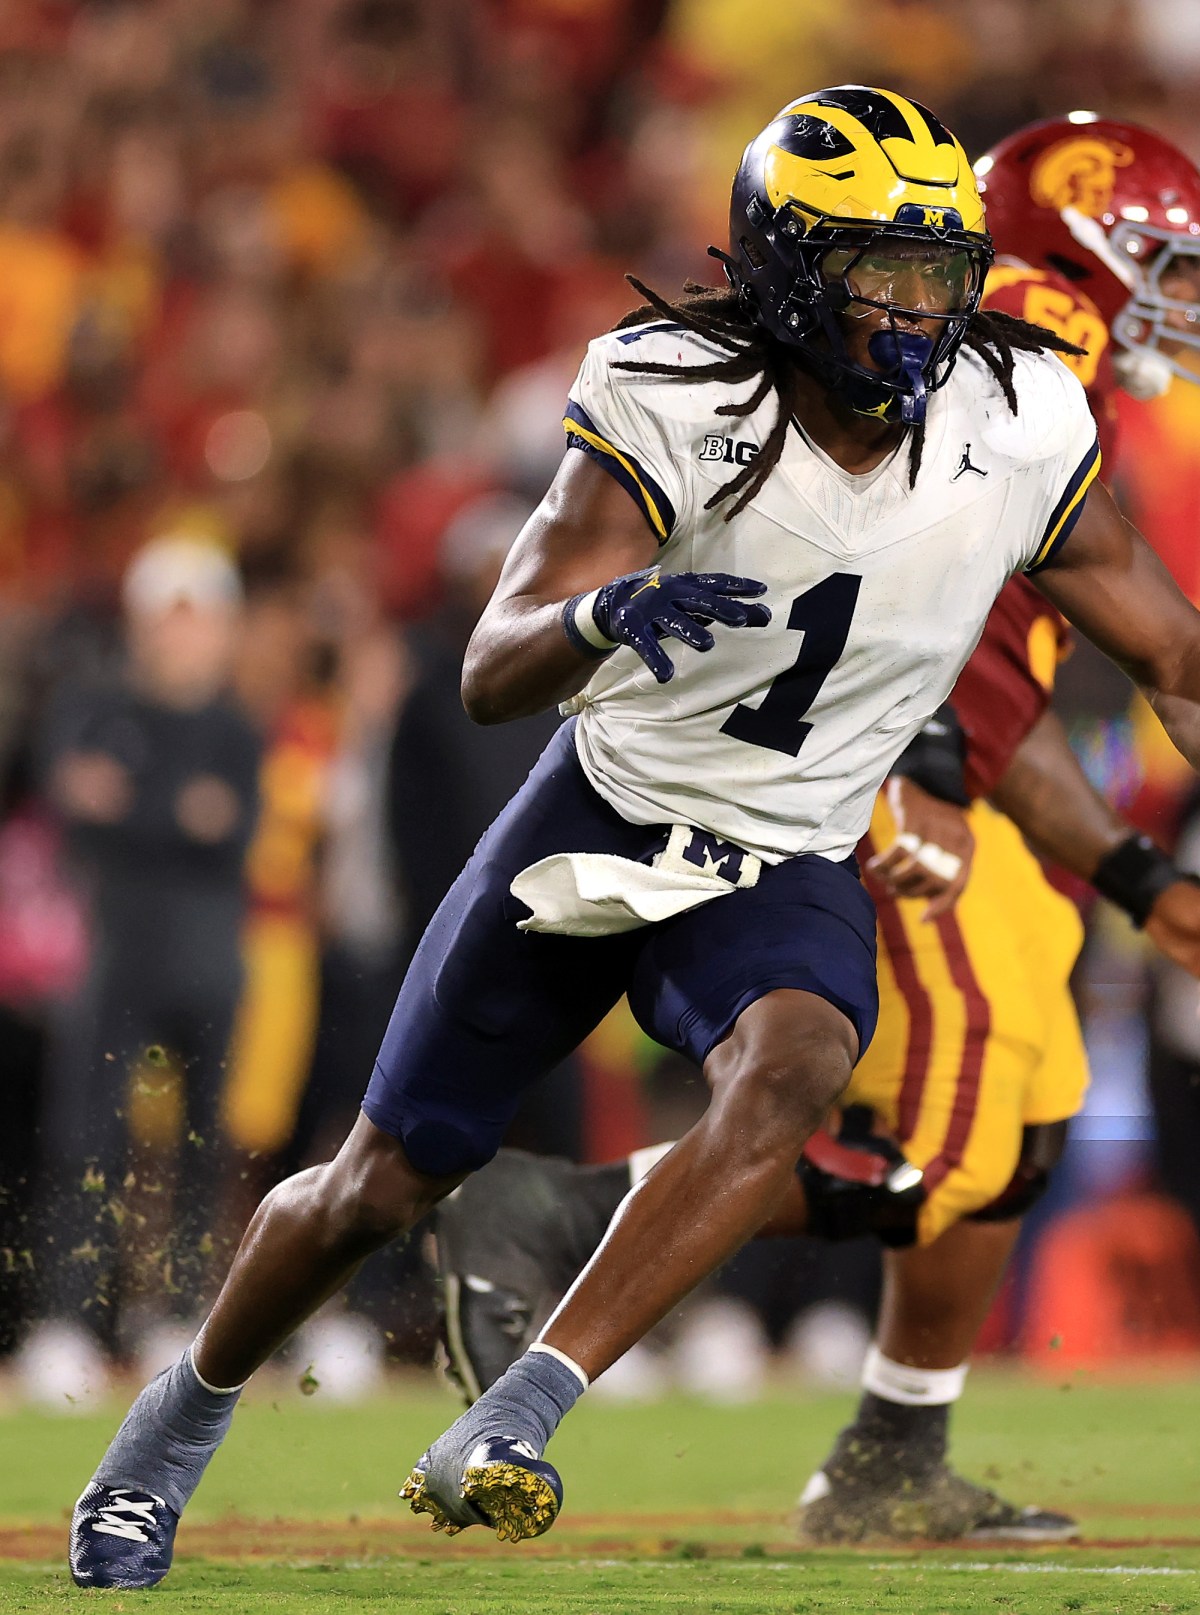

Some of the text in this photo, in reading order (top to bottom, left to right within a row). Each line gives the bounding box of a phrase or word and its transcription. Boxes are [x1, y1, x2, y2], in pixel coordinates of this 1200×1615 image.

[922, 208, 945, 226] M
[719, 571, 863, 758] 1
[682, 824, 750, 885] M
